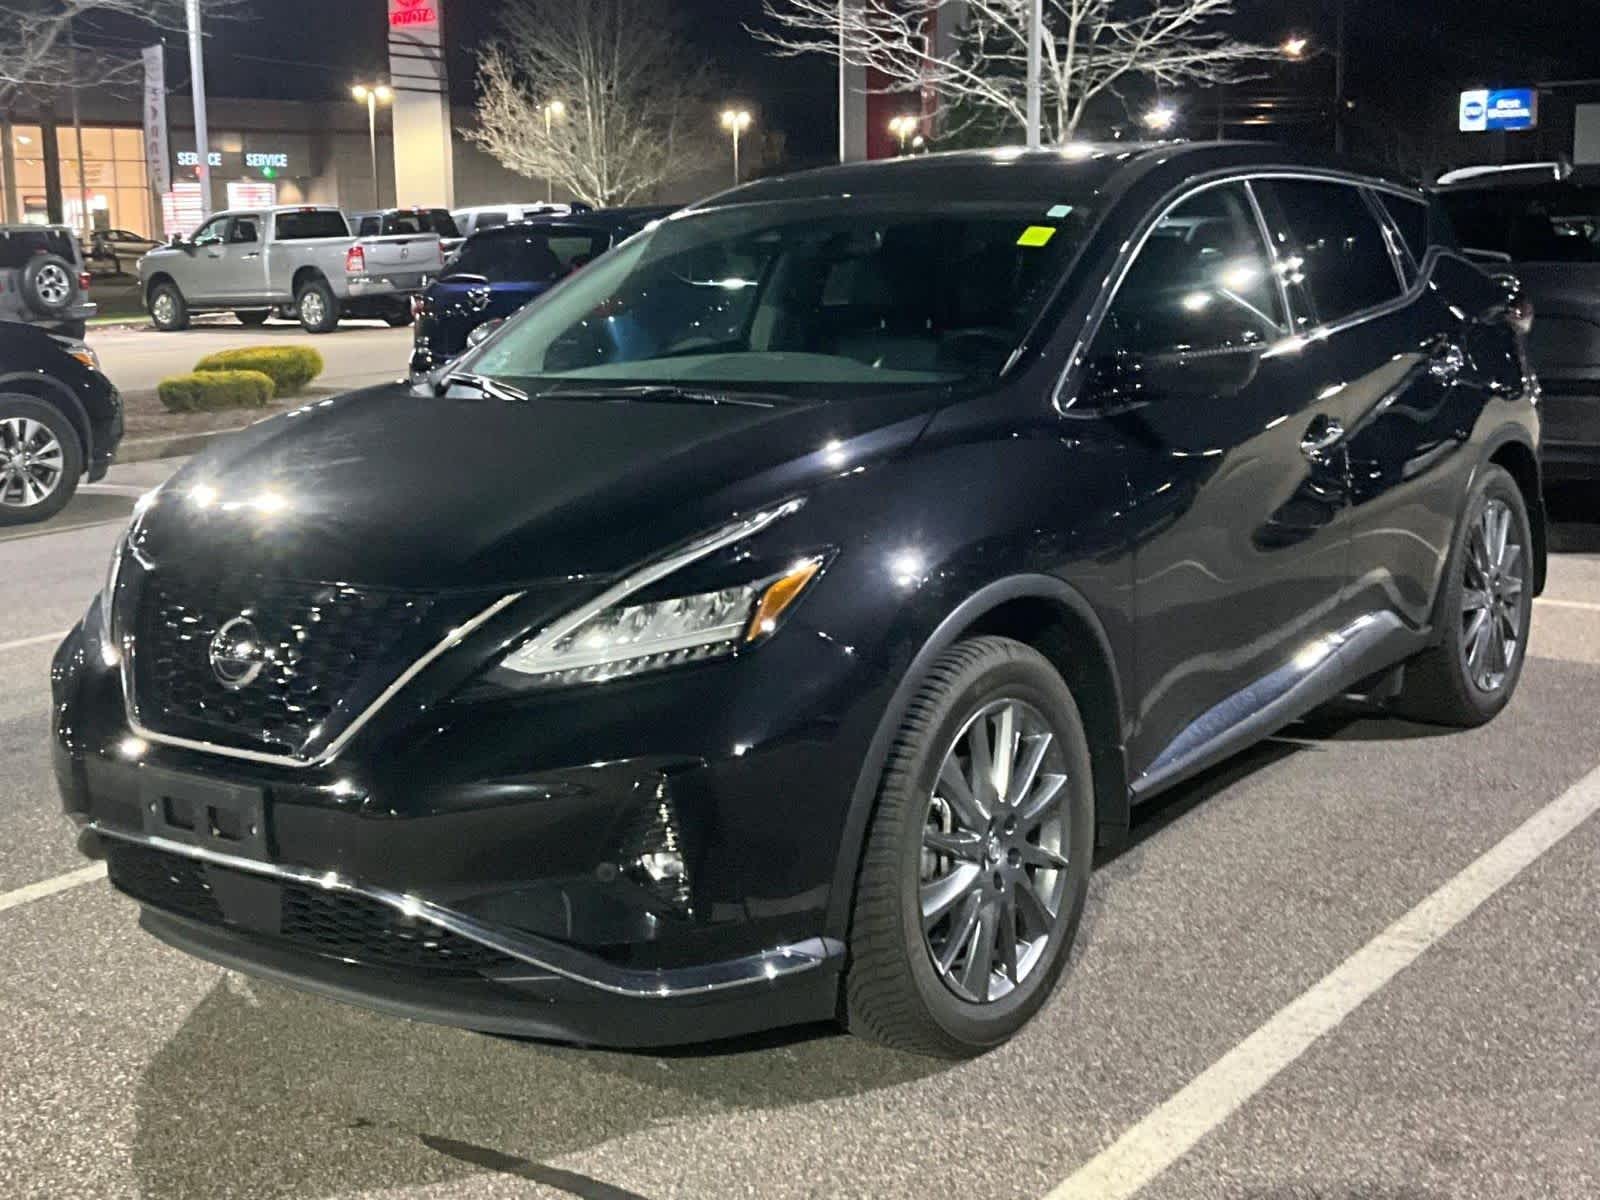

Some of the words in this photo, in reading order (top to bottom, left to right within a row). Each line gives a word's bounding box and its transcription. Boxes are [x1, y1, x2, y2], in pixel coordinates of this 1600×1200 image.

[390, 9, 435, 24] TOYOTA
[177, 152, 222, 166] SERCE
[246, 153, 287, 167] SERVICE
